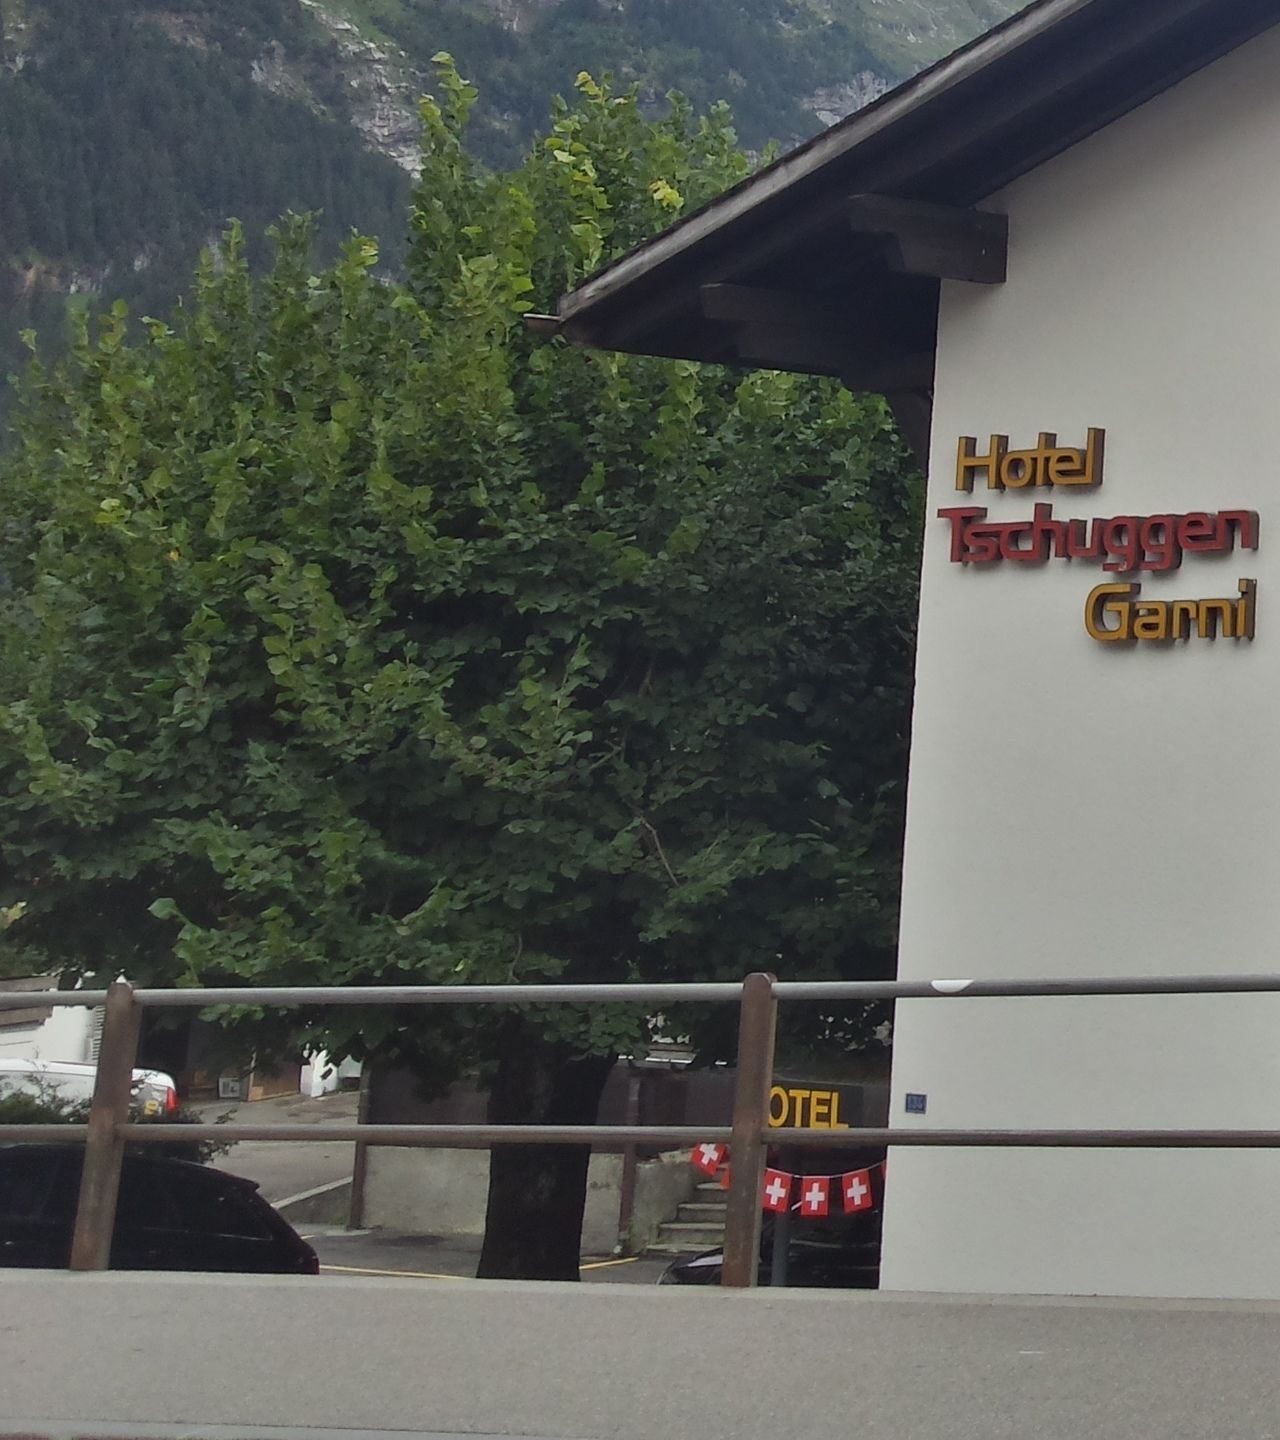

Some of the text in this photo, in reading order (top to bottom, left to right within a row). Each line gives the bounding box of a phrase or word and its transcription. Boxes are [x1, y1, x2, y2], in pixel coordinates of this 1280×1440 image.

[955, 428, 1105, 491] Hotel
[937, 503, 1260, 572] Tschuggen
[1084, 578, 1257, 642] Garni
[767, 1086, 849, 1129] OTEL
